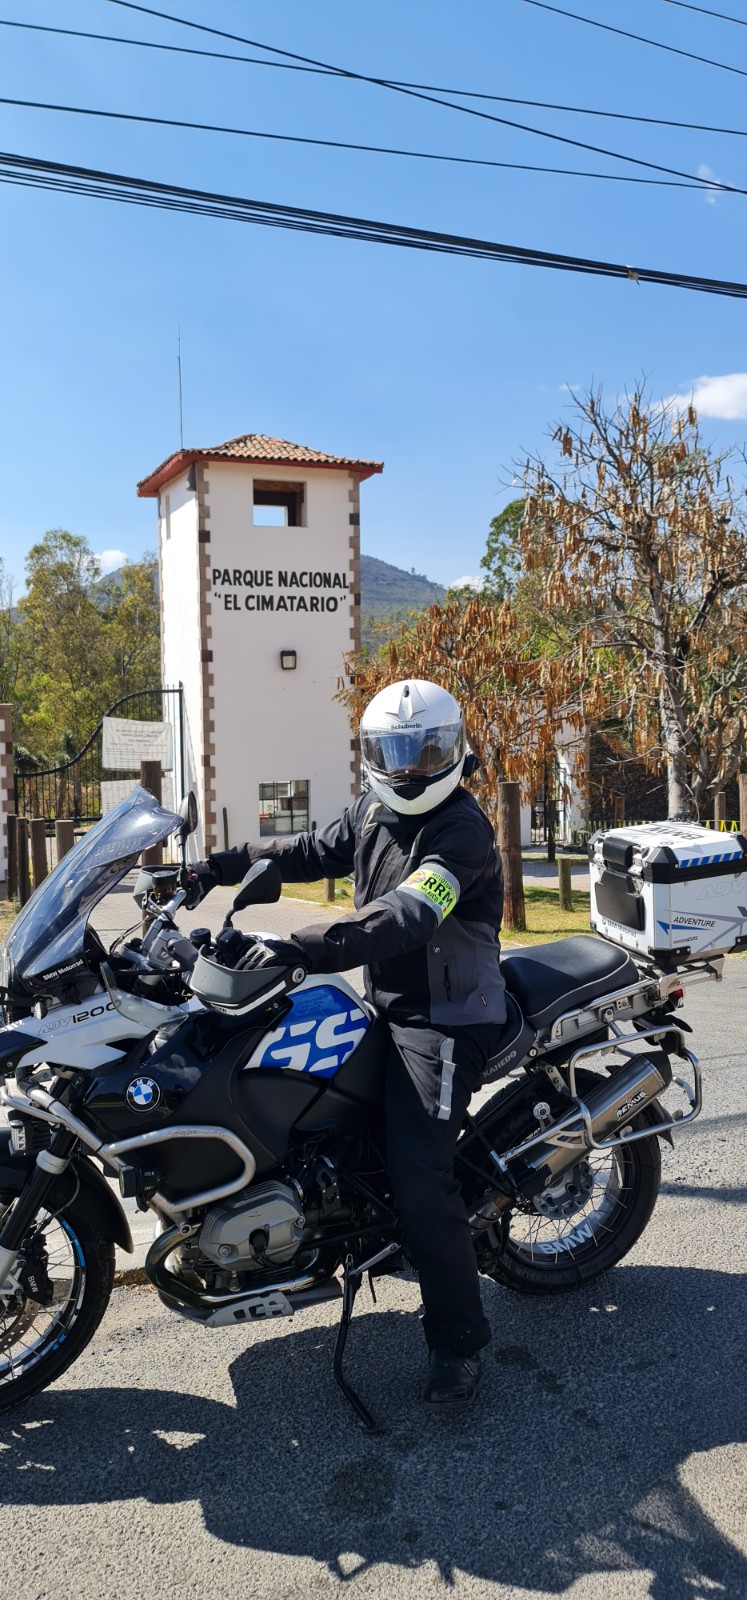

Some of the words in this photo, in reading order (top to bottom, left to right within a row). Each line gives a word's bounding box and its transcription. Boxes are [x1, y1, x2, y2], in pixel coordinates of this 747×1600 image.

[212, 568, 273, 588] PARQUE
[278, 570, 349, 589] NACIONAL
[423, 876, 453, 908] RRM
[673, 916, 717, 928] ADVENTURE
[42, 971, 59, 981] BMW
[57, 958, 84, 975] Motorrad
[243, 1008, 366, 1072] GS
[483, 1050, 517, 1078] KAHEDO
[128, 1079, 154, 1093] BMW
[616, 1090, 647, 1121] REMUS
[538, 1223, 593, 1255] BMW
[28, 1275, 39, 1293] BMW
